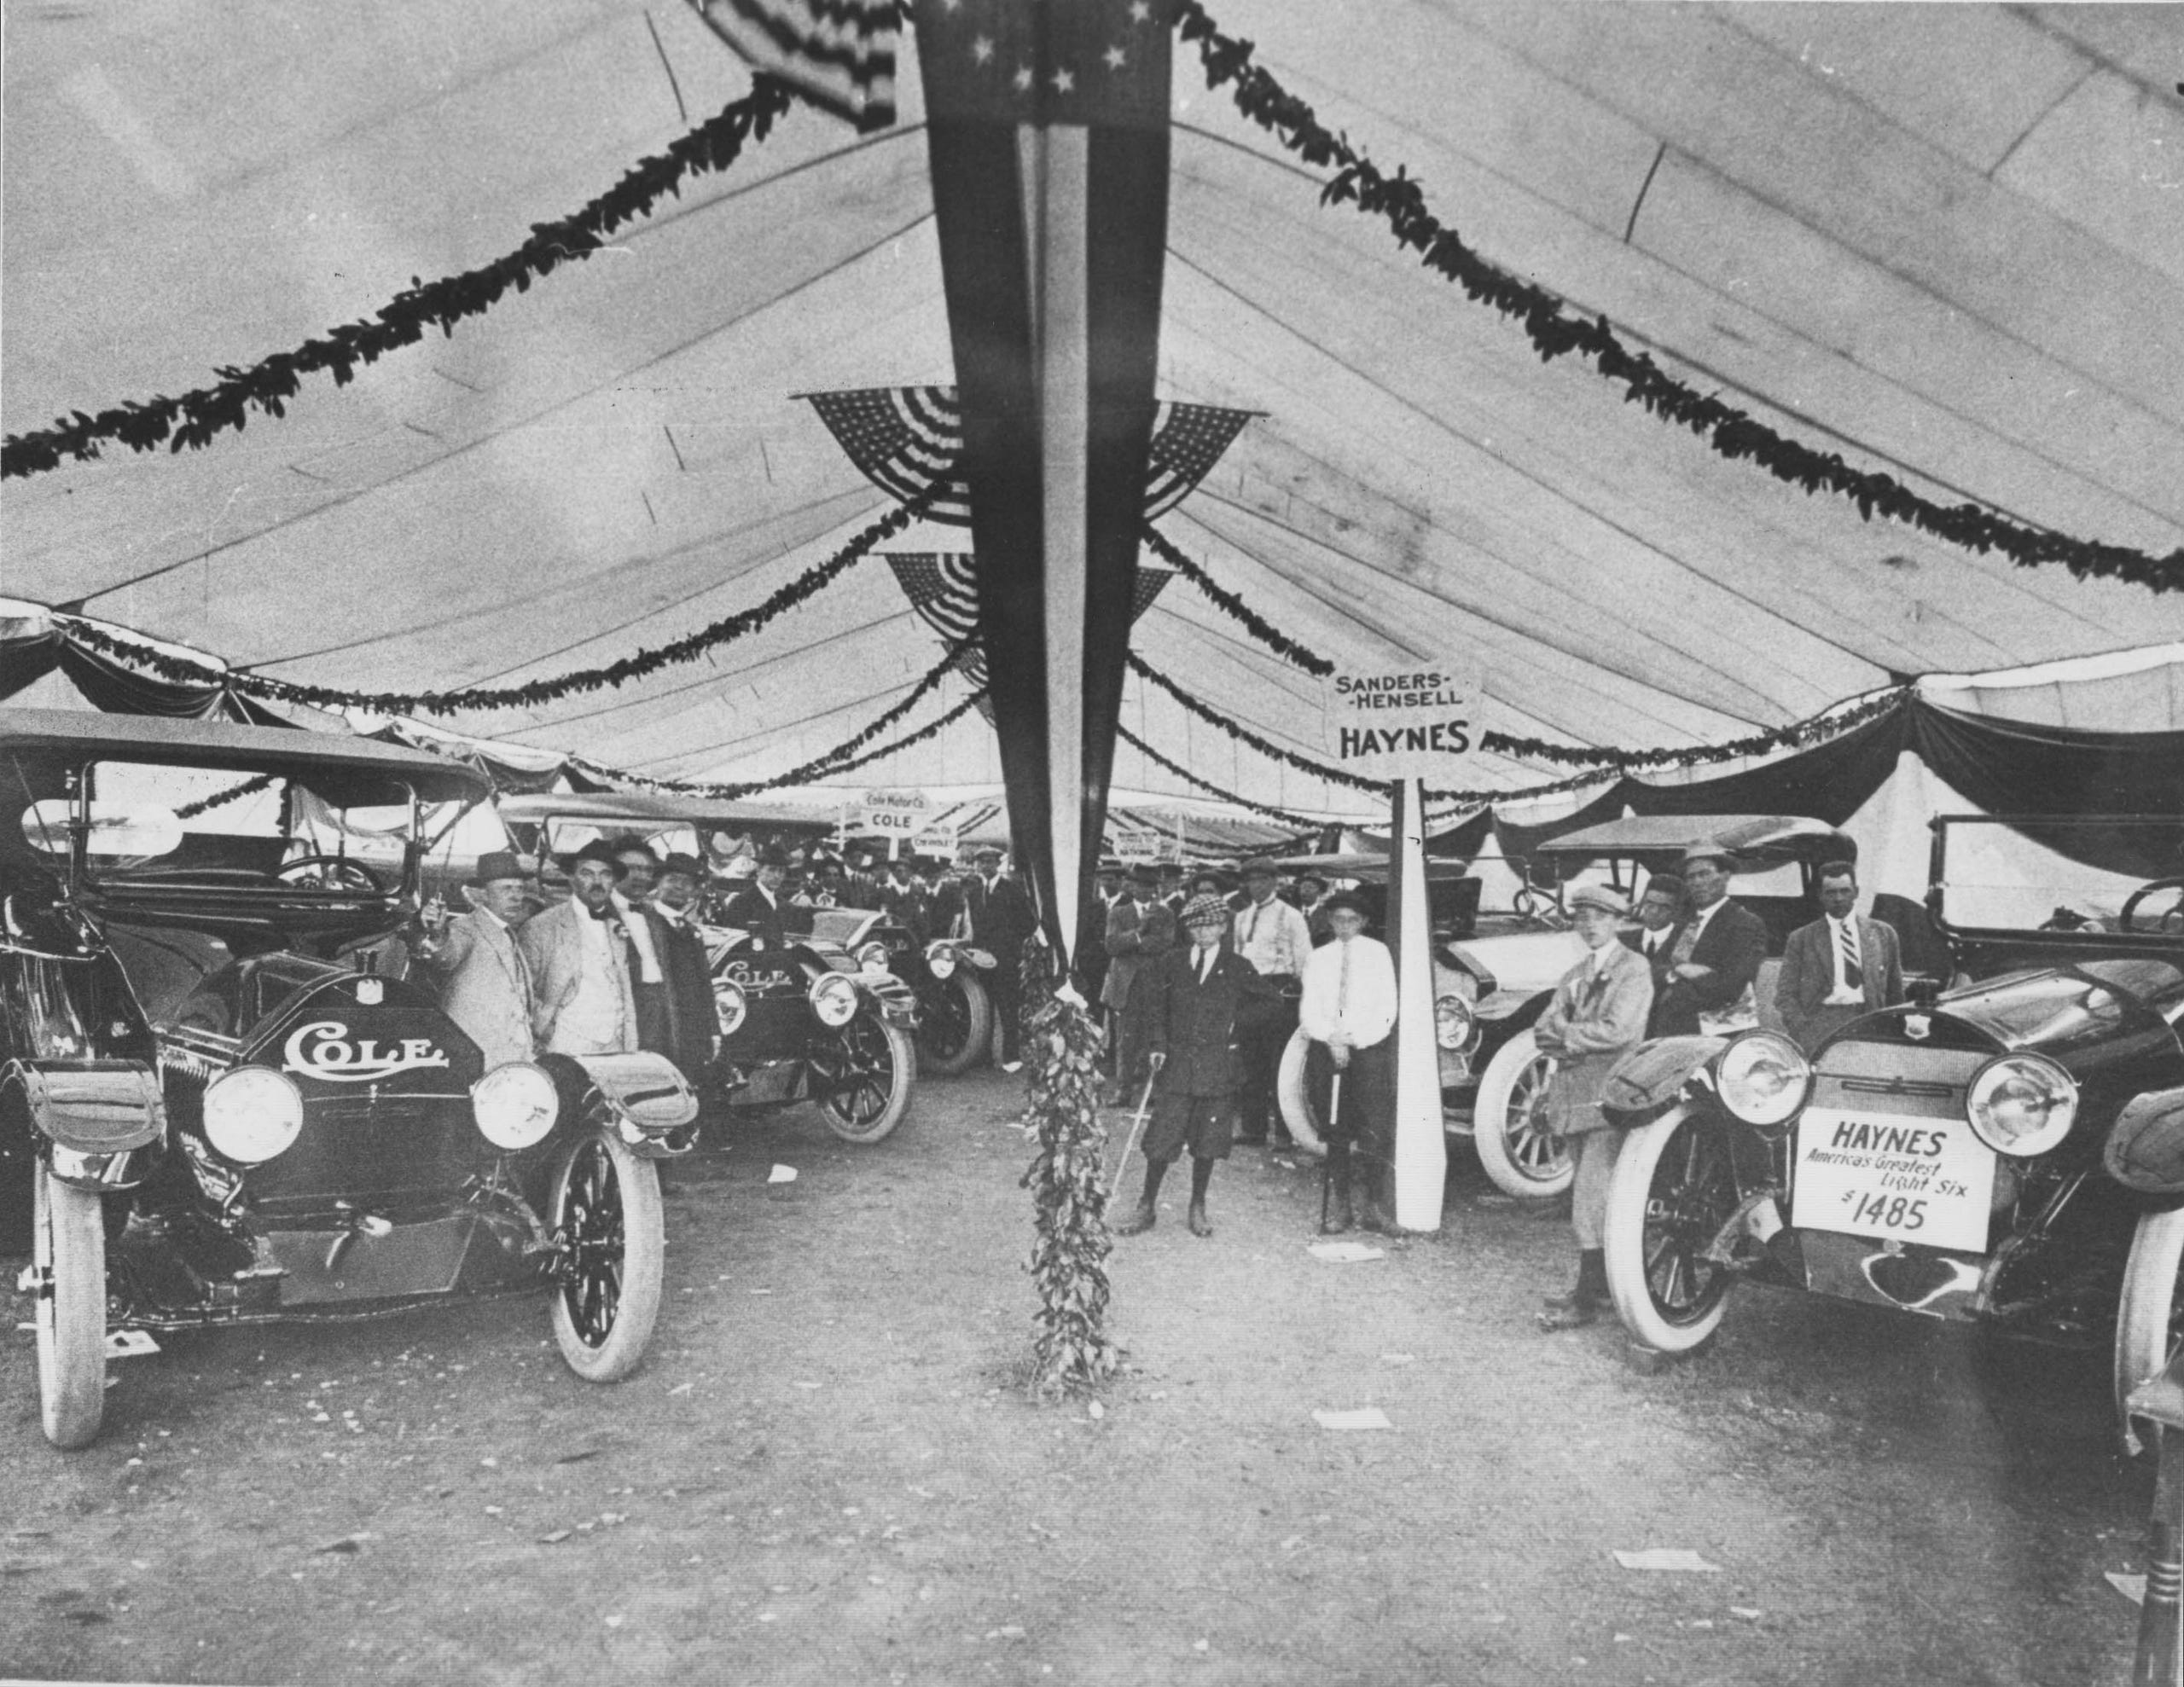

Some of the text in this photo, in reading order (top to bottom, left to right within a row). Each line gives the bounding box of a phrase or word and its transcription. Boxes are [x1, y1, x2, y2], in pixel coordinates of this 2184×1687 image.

[1335, 672, 1451, 695] SANDERS-
[1349, 690, 1464, 710] -HENSELL
[1339, 720, 1470, 760] HAYNES
[872, 813, 911, 829] COLE
[1831, 1121, 1948, 1157] HAYNES
[1875, 1154, 1942, 1177] Greatest
[1935, 1180, 1969, 1198] Six
